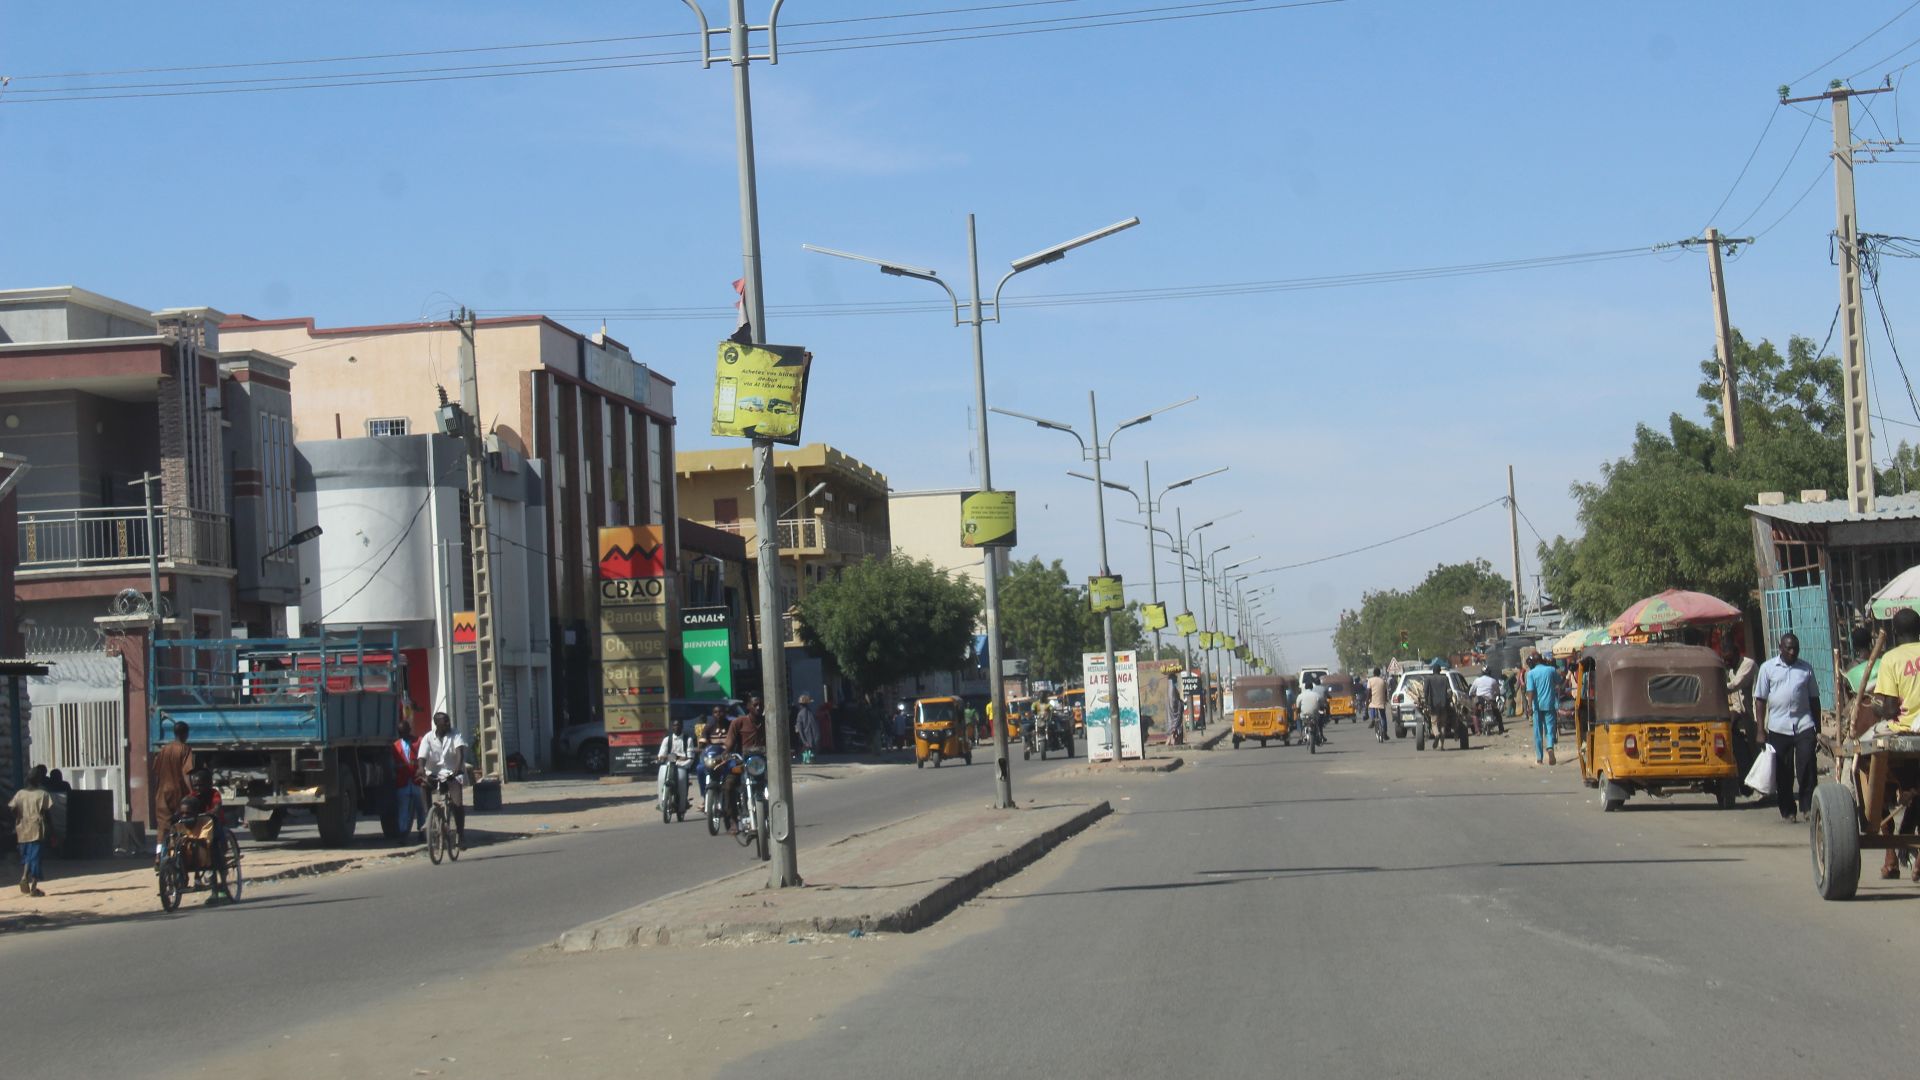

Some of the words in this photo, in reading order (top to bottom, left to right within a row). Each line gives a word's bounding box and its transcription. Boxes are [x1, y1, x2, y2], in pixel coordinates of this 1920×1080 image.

[602, 578, 662, 599] CBAO
[604, 610, 661, 625] Banque
[684, 613, 725, 624] CANAL+
[605, 638, 662, 654] Change
[683, 639, 728, 649] BIENVENUE
[1089, 675, 1099, 685] LA
[1100, 673, 1132, 685] TENGA
